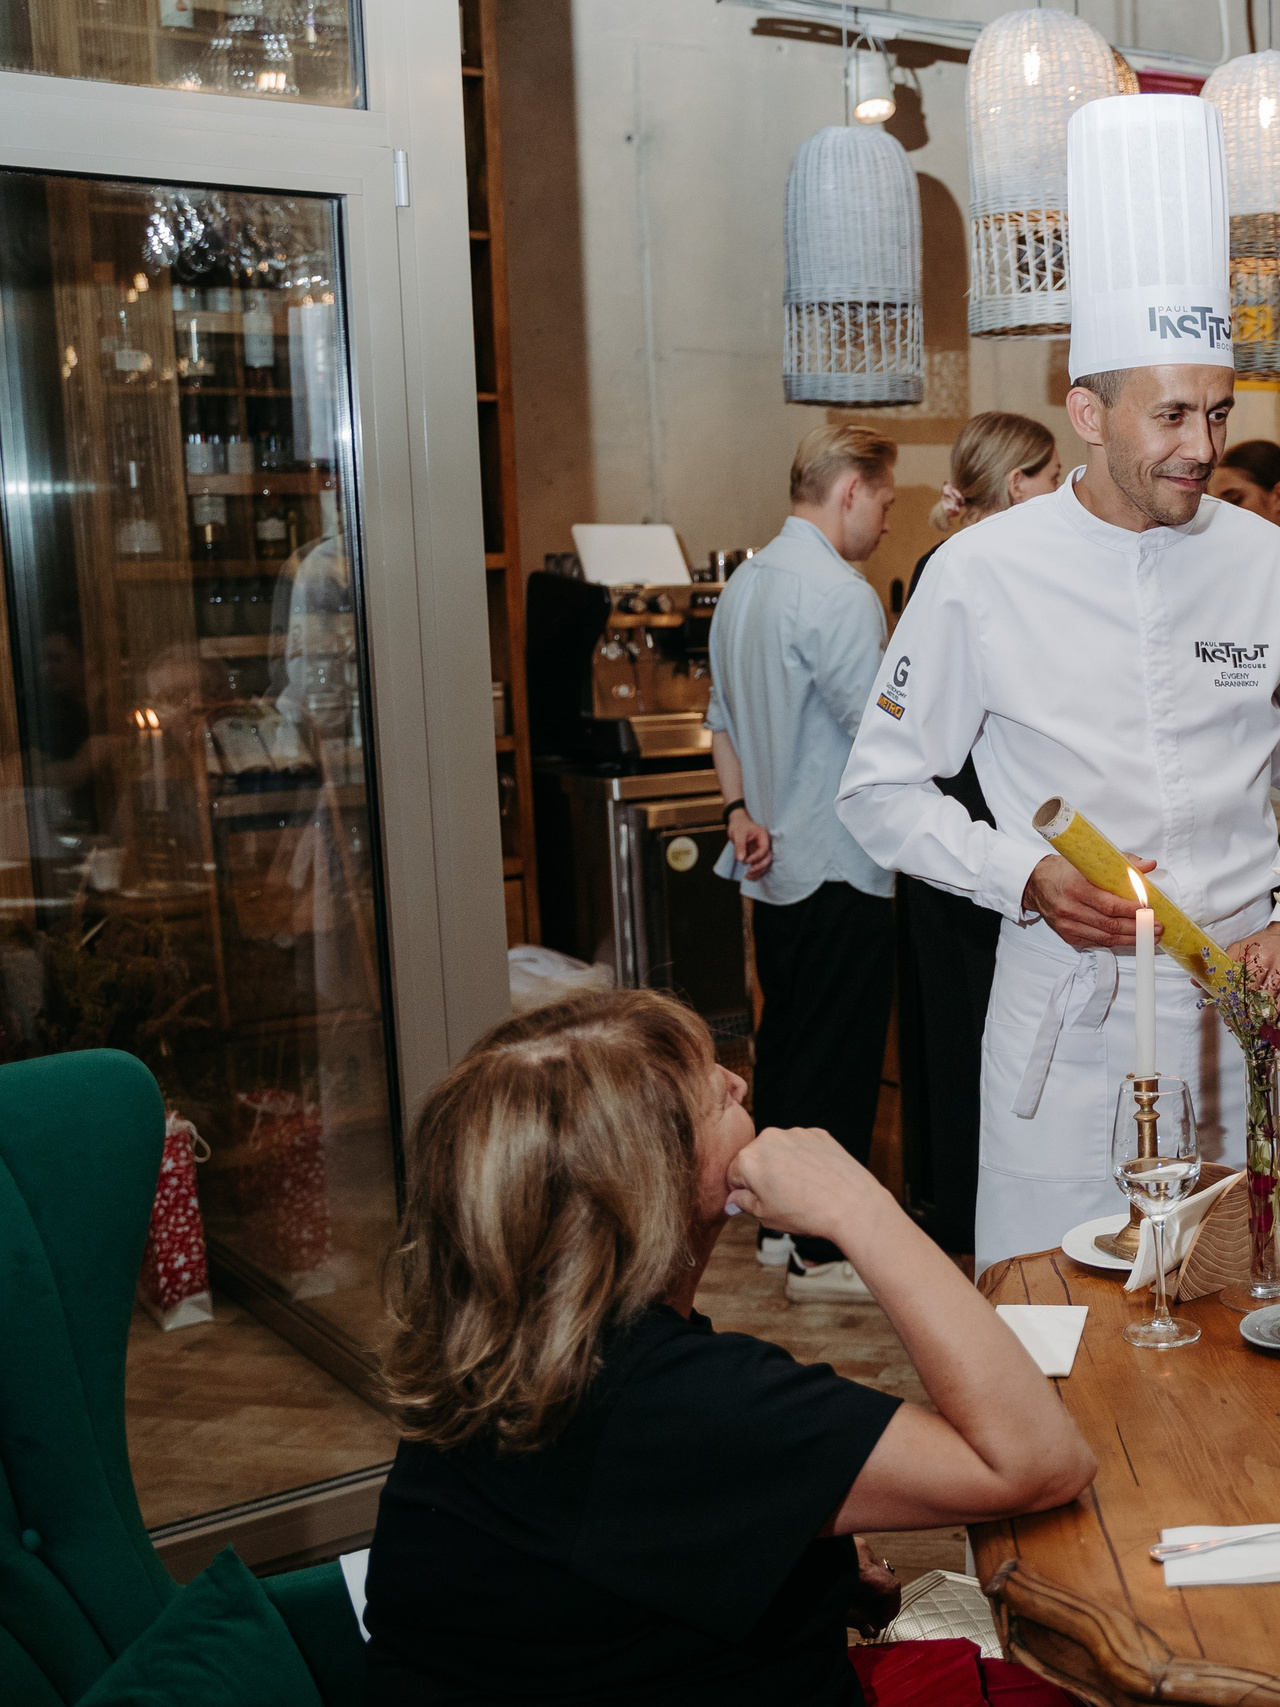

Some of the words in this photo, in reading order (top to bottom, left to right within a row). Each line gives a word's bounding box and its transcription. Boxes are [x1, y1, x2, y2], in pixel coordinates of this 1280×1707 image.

[1158, 305, 1188, 313] PAUL
[1195, 641, 1269, 668] INSTITUT
[893, 656, 911, 687] G
